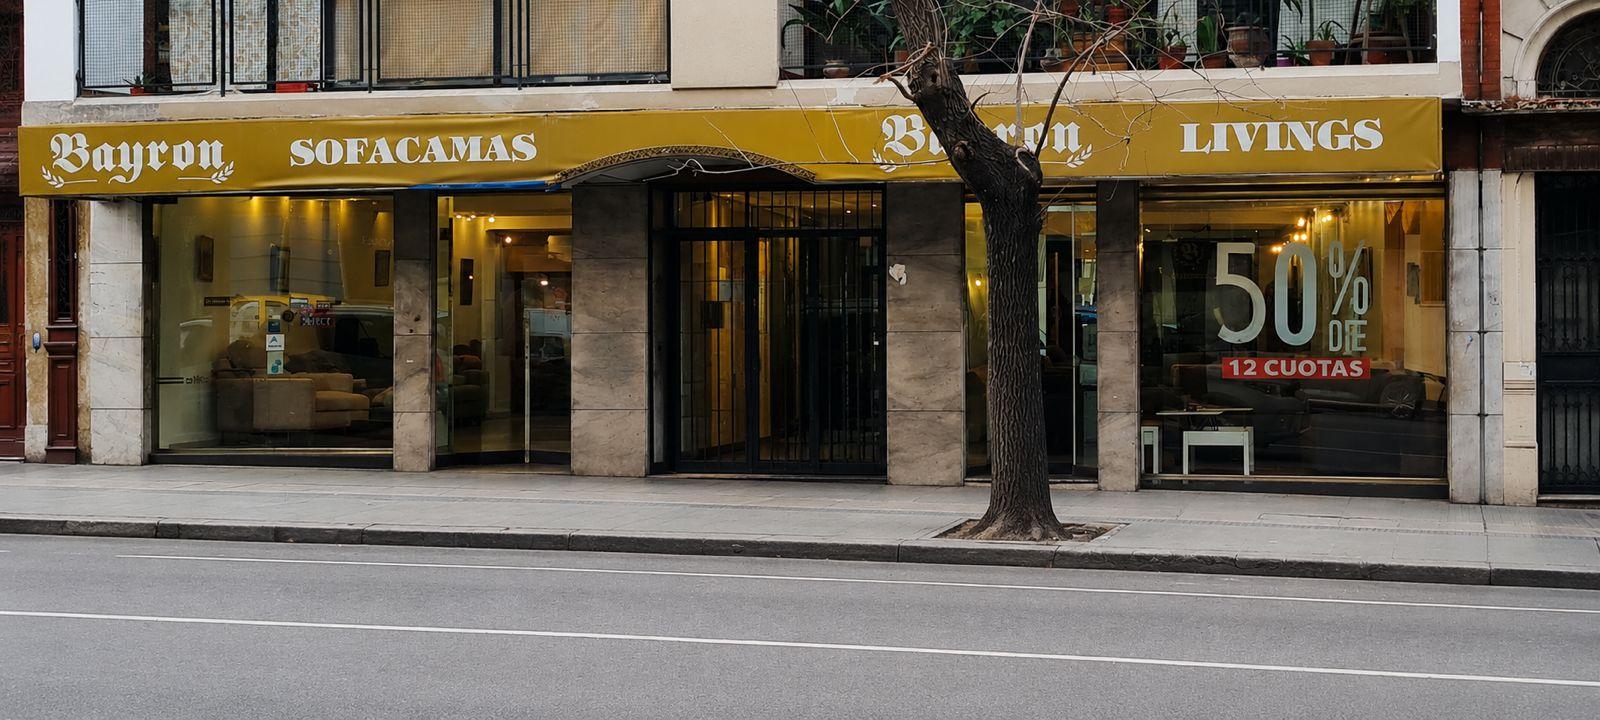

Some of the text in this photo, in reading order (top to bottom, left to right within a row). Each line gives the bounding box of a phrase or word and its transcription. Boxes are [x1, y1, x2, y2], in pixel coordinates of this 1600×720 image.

[881, 114, 1384, 156] Bron LIVINGS
[50, 132, 538, 184] Bayron SOFACAMAS
[1229, 359, 1364, 377] 12 CUOTAS
